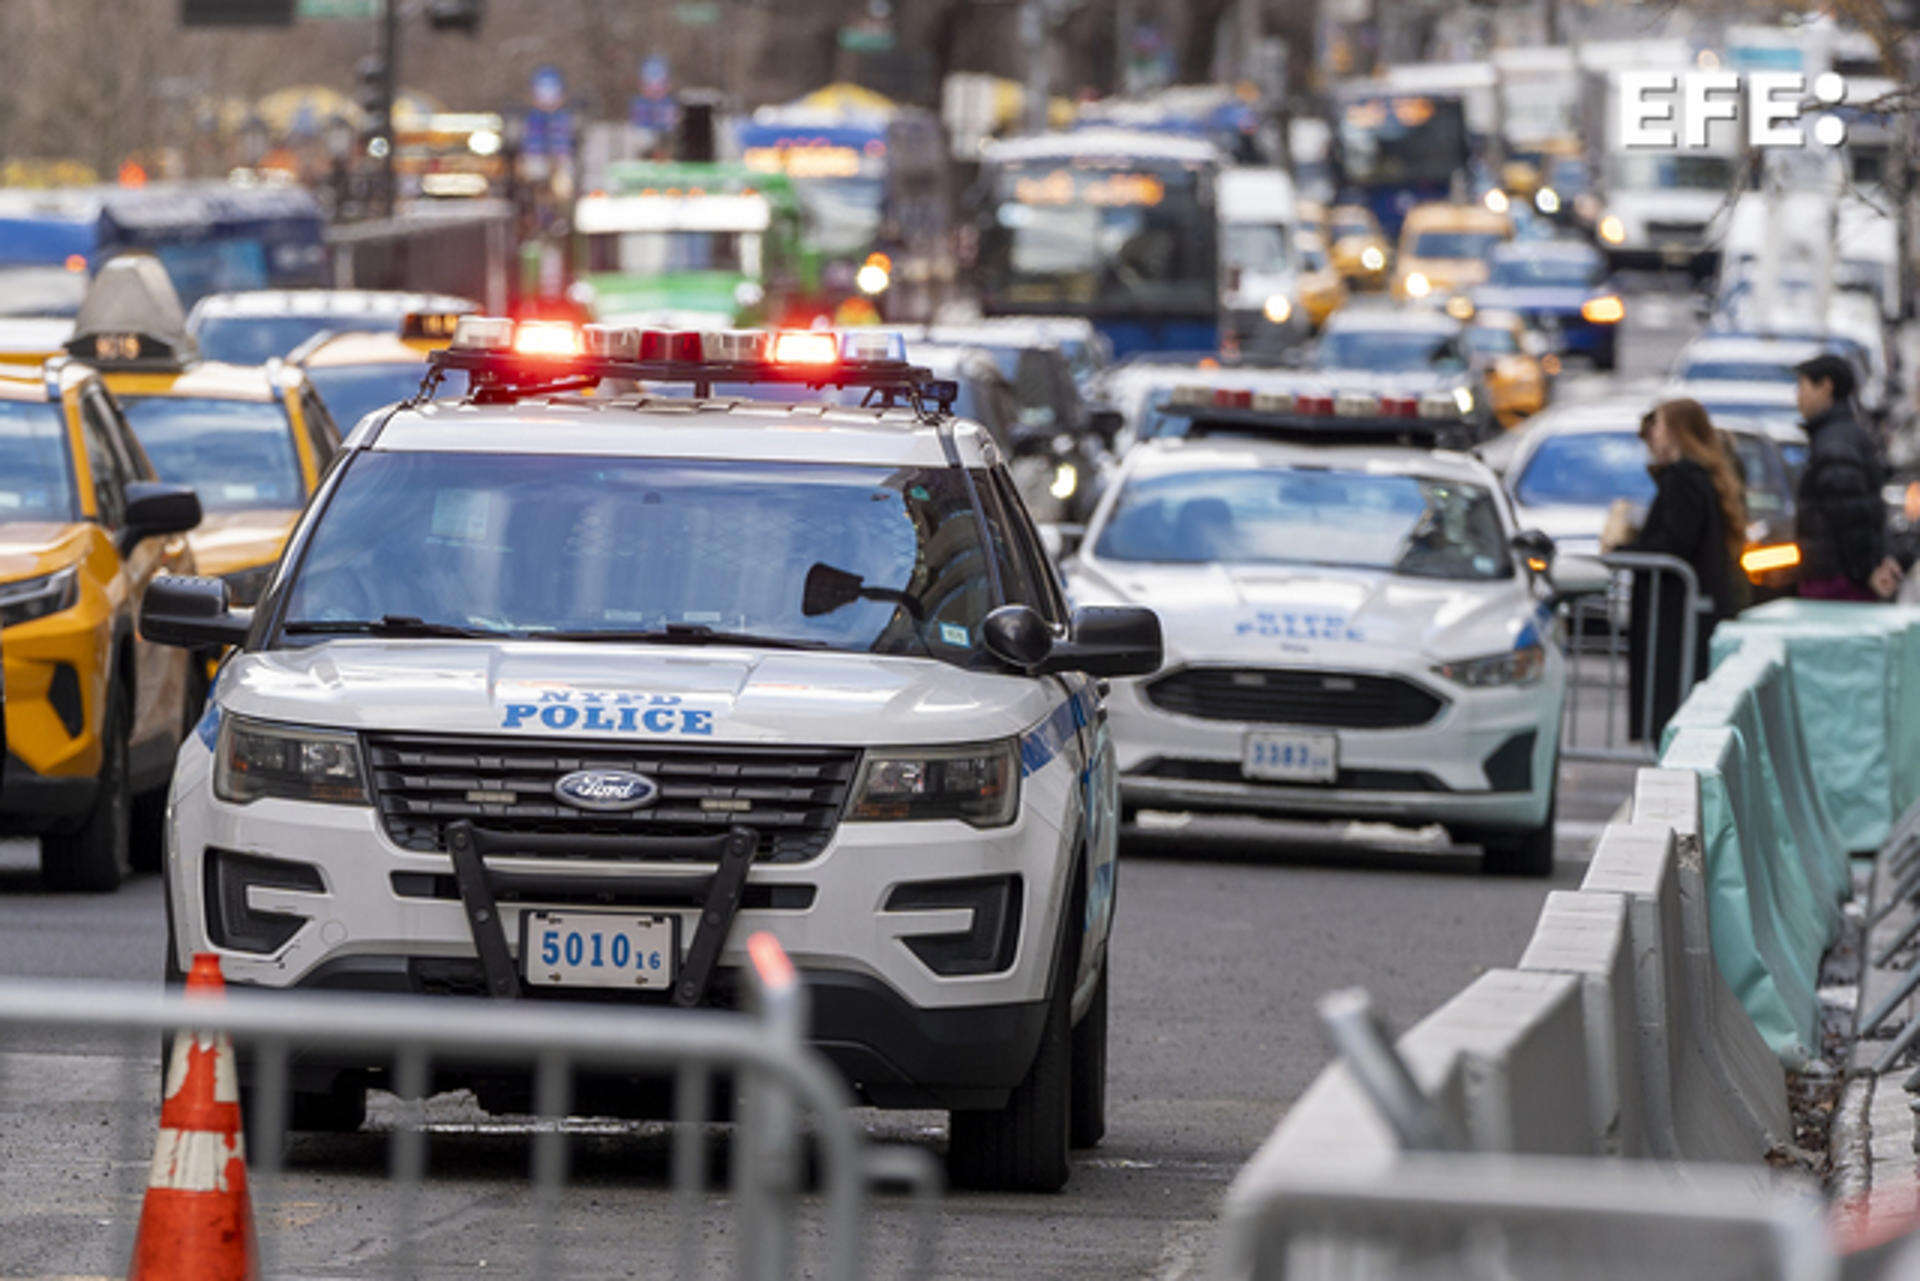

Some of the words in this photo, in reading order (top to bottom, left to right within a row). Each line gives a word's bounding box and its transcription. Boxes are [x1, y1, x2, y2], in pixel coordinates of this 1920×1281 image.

[1235, 621, 1366, 641] POLICE
[501, 704, 713, 735] POLICE
[575, 771, 634, 798] Ford
